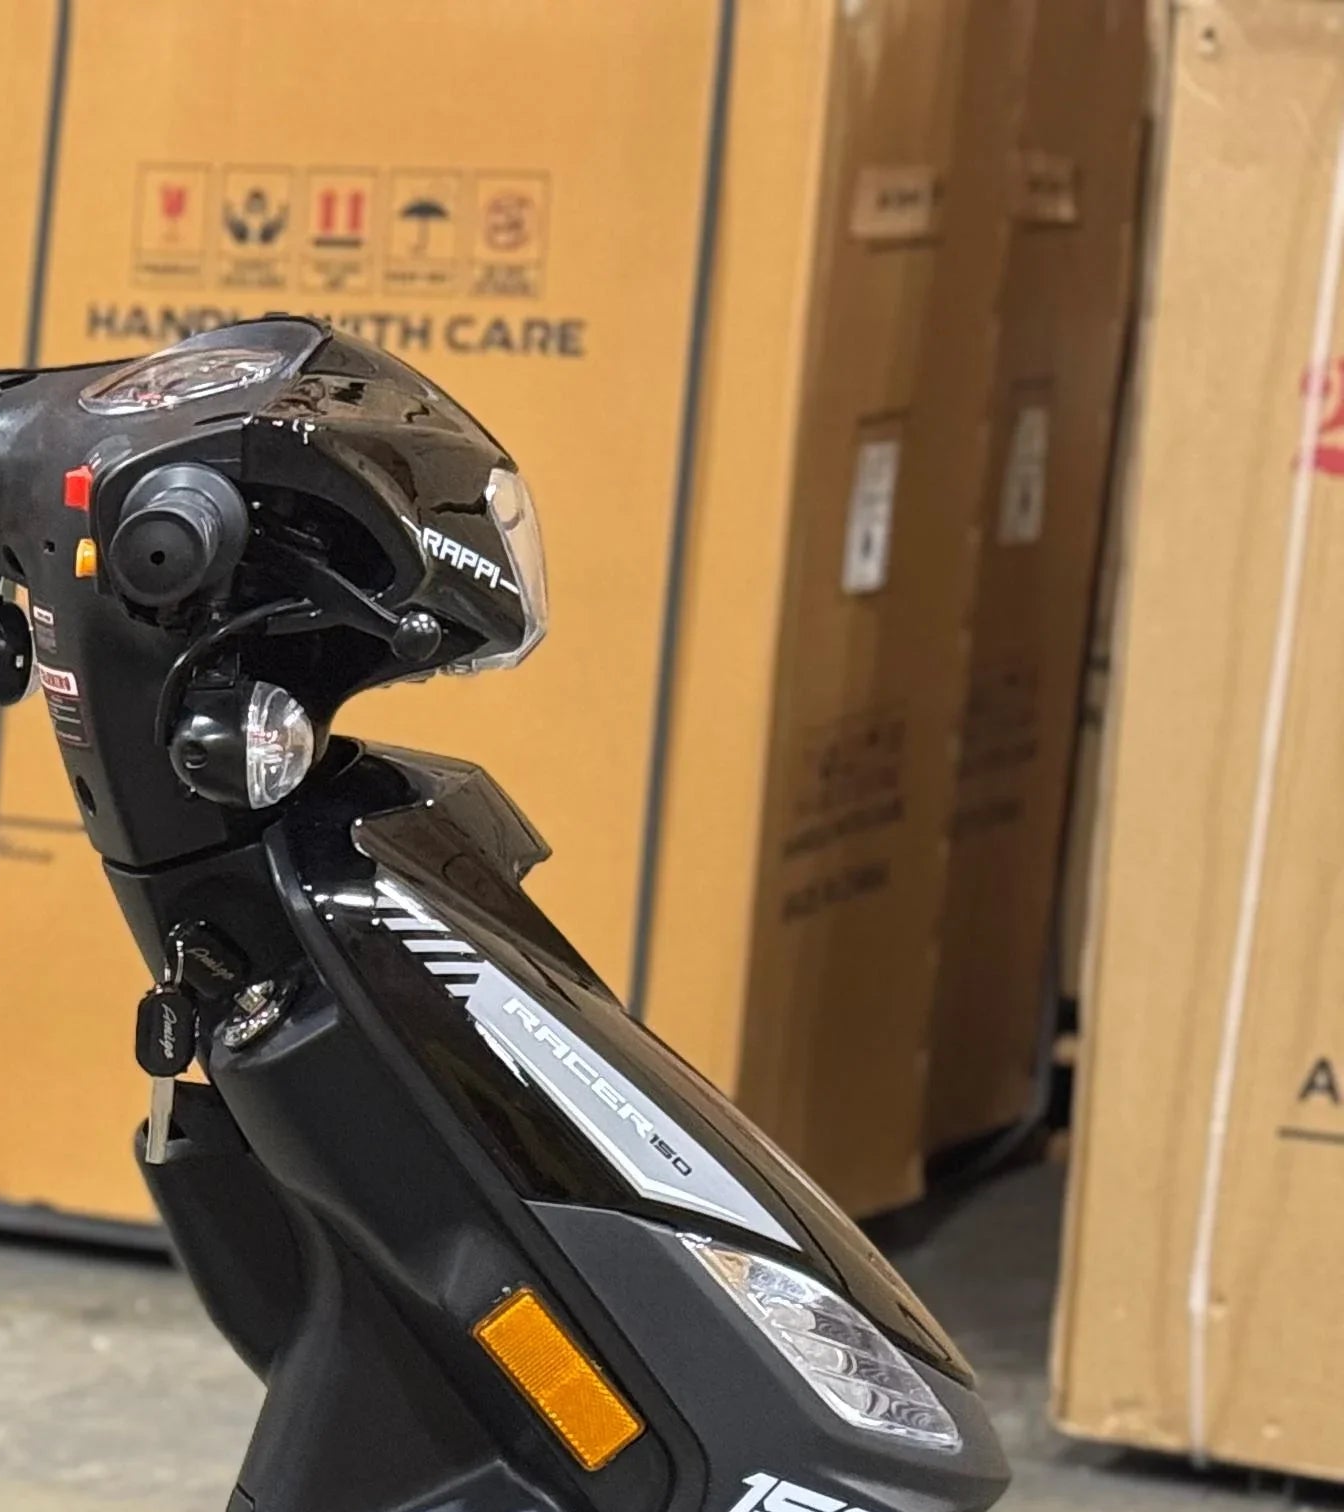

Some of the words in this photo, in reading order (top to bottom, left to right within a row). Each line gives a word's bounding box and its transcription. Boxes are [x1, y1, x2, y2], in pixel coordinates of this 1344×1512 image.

[445, 314, 587, 358] CARE
[422, 527, 501, 589] RAPPI
[502, 997, 654, 1139] RACER
[648, 1133, 693, 1177] 150
